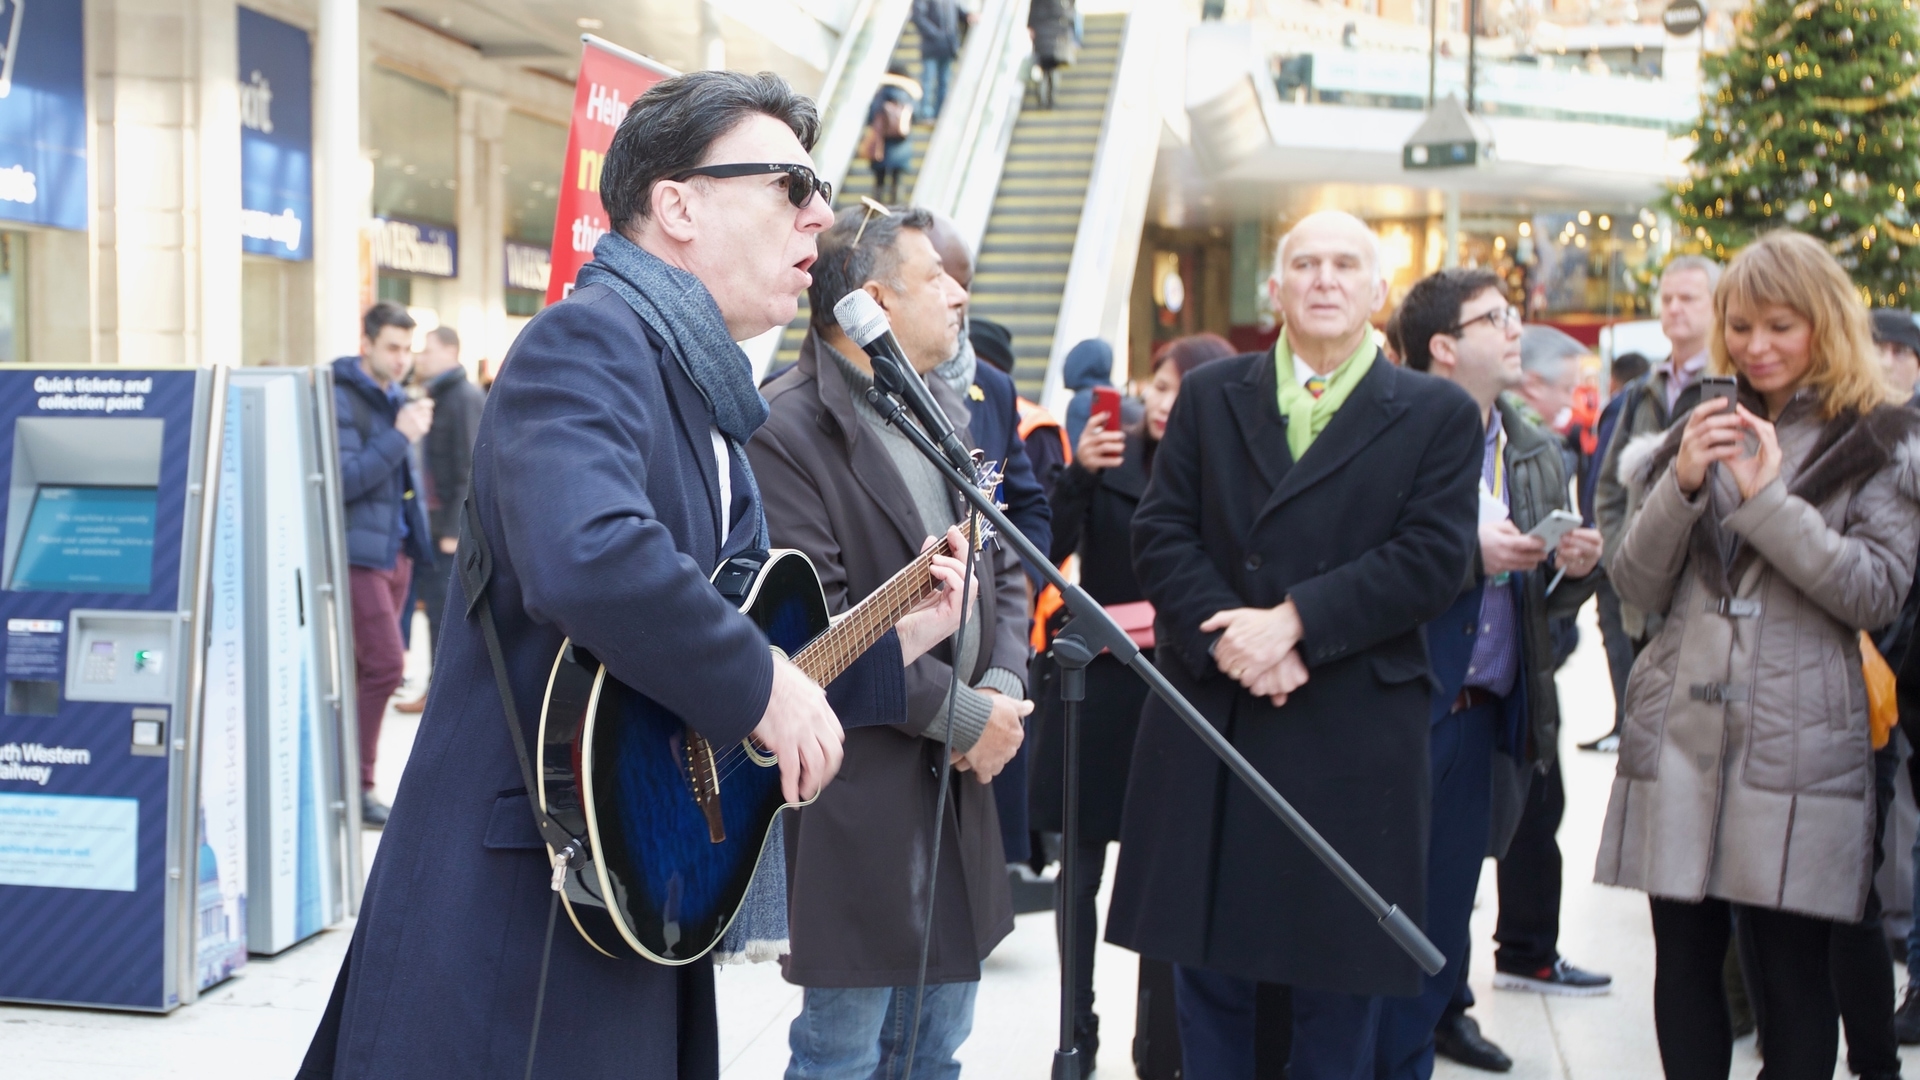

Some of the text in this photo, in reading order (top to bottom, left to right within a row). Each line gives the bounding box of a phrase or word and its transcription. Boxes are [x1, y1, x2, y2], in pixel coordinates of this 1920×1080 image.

[34, 376, 153, 394] Quick tickets and
[38, 393, 145, 413] collection point
[222, 484, 236, 630] collection
[224, 640, 237, 697] and
[21, 743, 91, 765] Western
[224, 705, 238, 808] tickets
